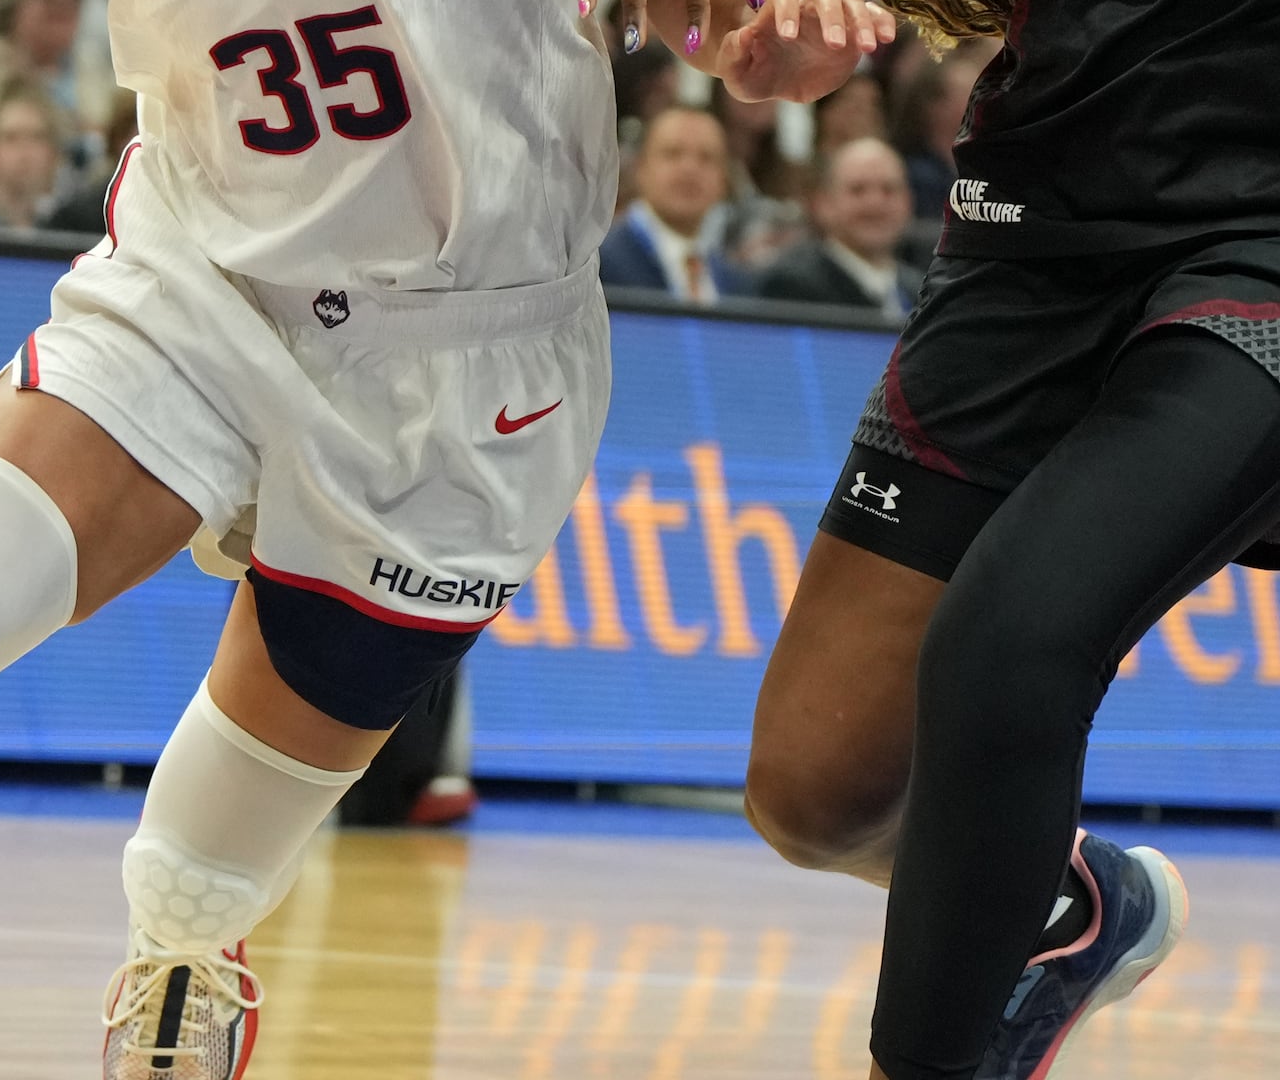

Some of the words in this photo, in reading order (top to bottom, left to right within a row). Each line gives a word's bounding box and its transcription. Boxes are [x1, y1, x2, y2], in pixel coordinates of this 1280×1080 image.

[209, 4, 412, 155] 35
[959, 178, 989, 201] THE
[960, 201, 1026, 223] CULTURE
[841, 495, 863, 509] UNDER
[863, 506, 900, 524] ARMOUR
